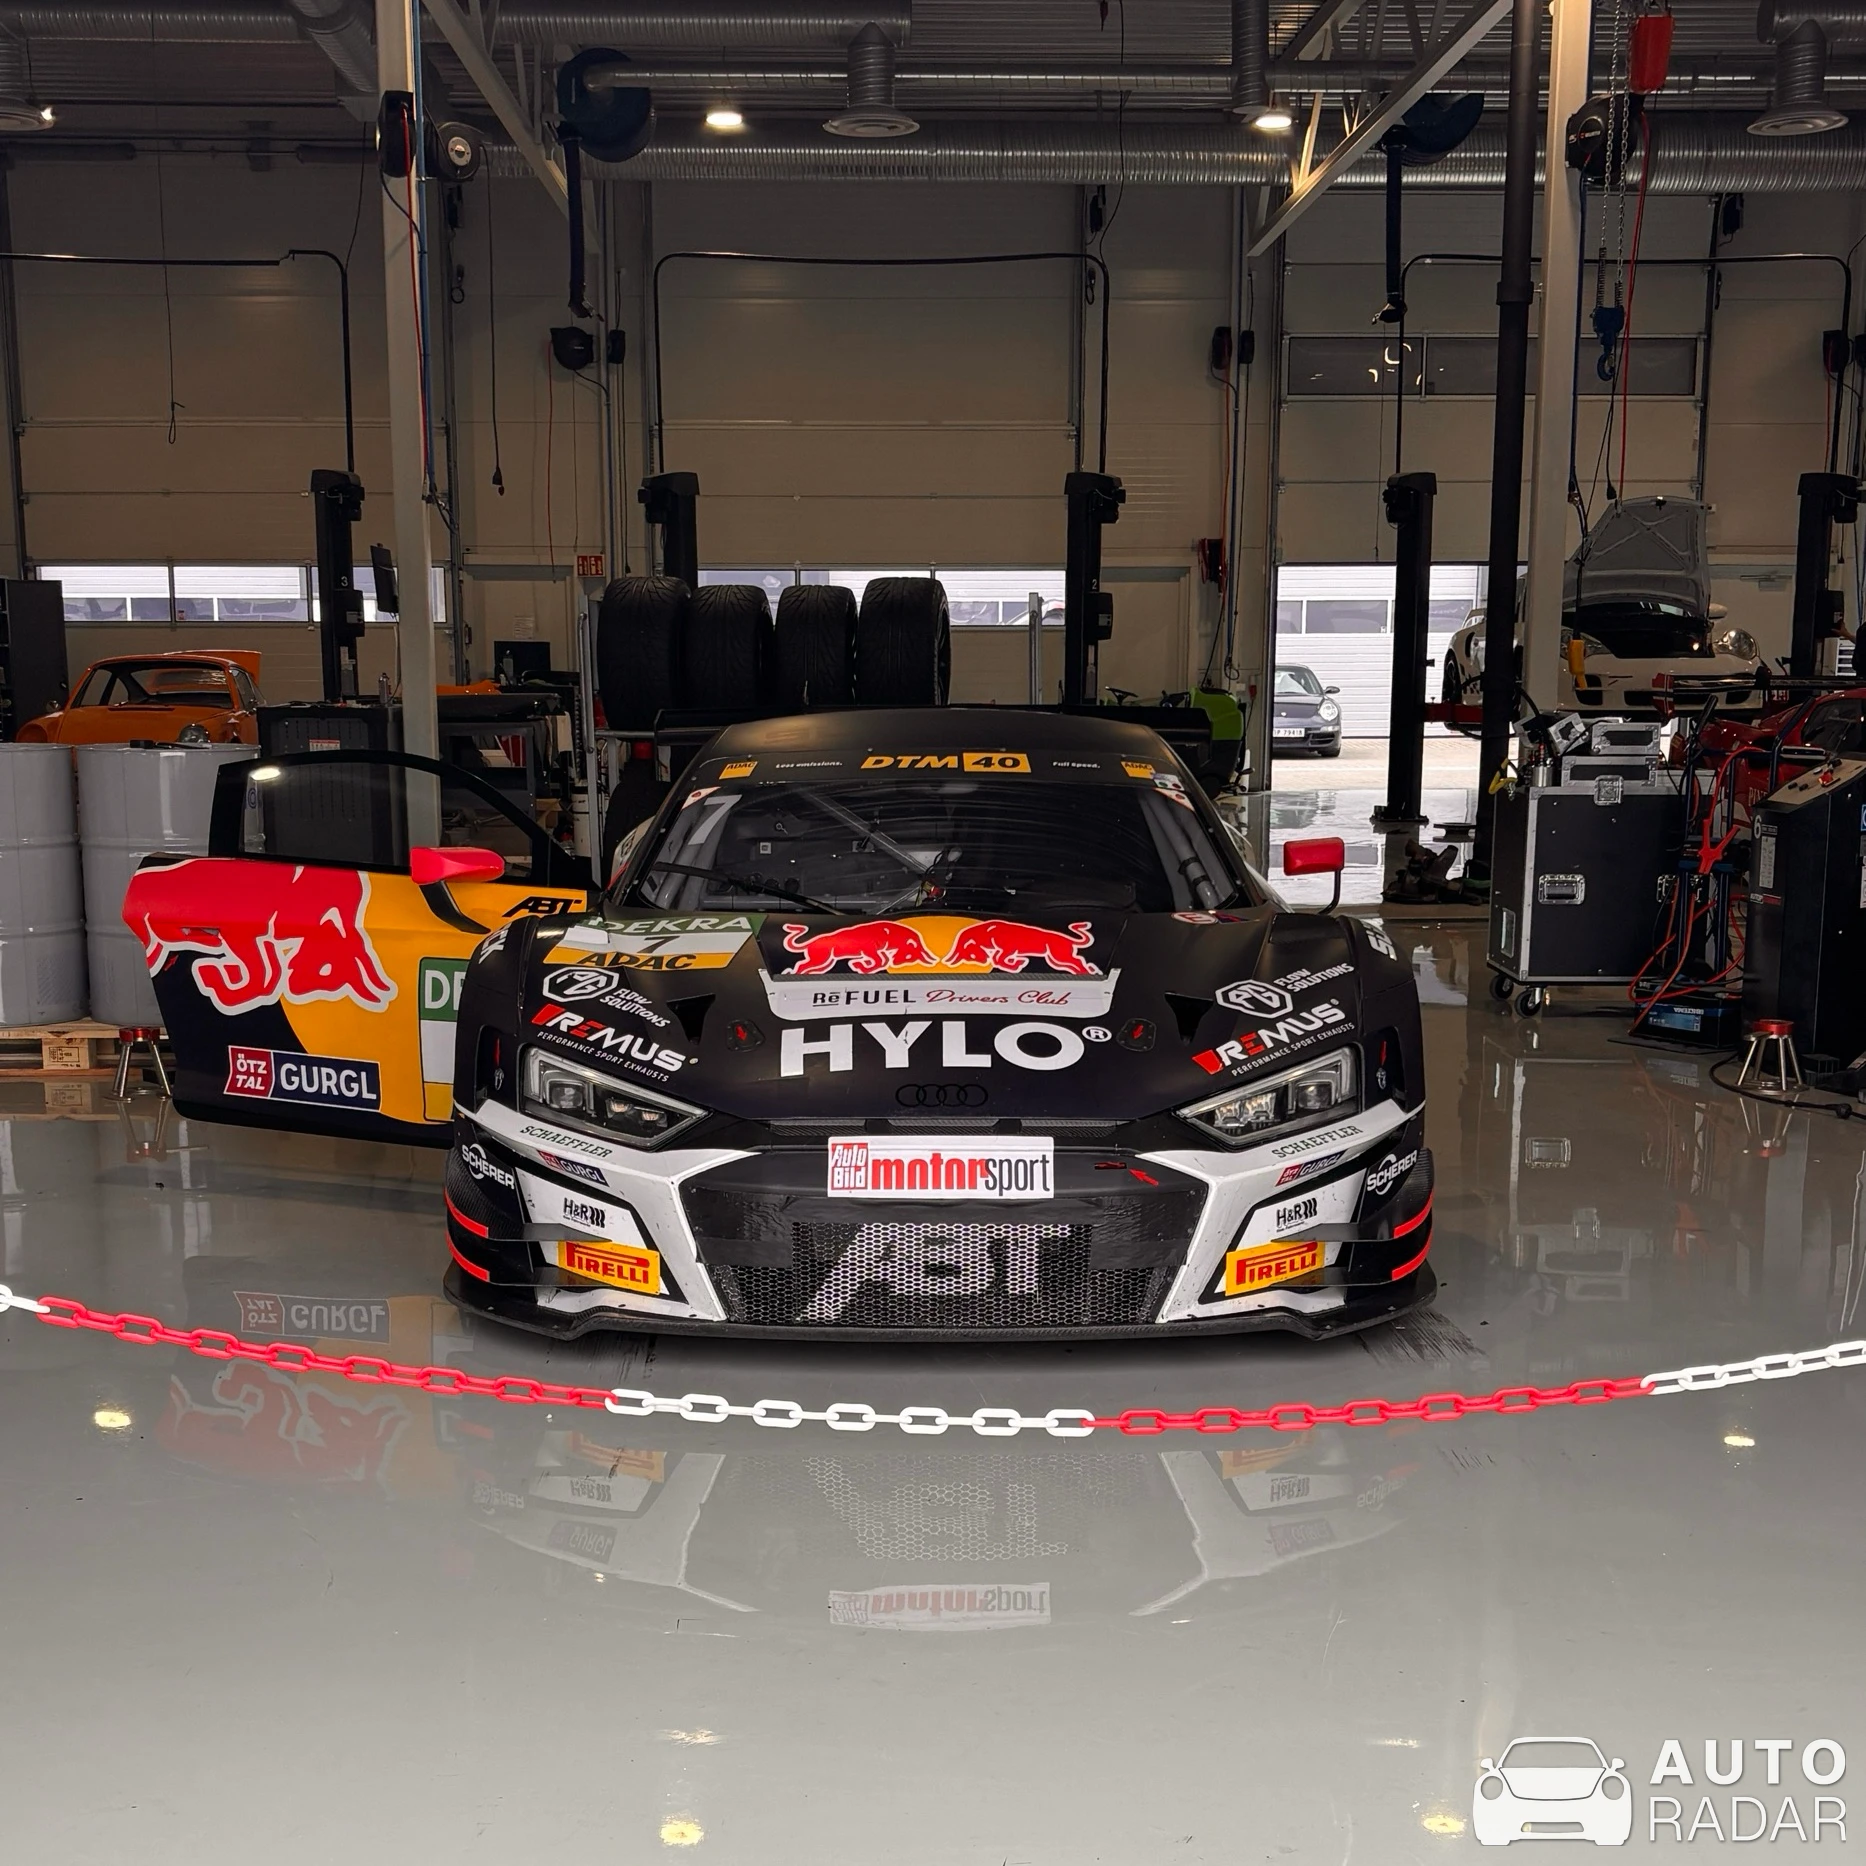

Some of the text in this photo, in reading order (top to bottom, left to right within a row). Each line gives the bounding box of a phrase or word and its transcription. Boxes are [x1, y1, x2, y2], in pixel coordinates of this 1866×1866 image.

[341, 576, 349, 587] 3
[1091, 579, 1097, 590] 2
[726, 761, 756, 771] ADAC
[860, 755, 1021, 769] DTM 40
[1124, 762, 1153, 770] ADAC
[688, 794, 742, 845] 7
[1753, 814, 1762, 839] 6
[502, 896, 583, 917] ABT
[588, 916, 752, 933] DEKRA
[643, 936, 680, 954] 7
[576, 952, 697, 970] ADAC
[1273, 968, 1312, 987] FLOW
[1286, 962, 1355, 993] SOLUTIONS
[612, 988, 653, 1005] FLOW
[926, 989, 1009, 1005] Drivers
[1017, 989, 1073, 1006] Club
[600, 995, 671, 1028] SOLUTIONS
[545, 1010, 687, 1073] REMUS
[1215, 1002, 1347, 1067] REMUS
[537, 1030, 670, 1083] PERFORMANCE SPORT EXHAUSTS
[1231, 1022, 1356, 1078] PERFORMANCE SPORT EXHAUSTS
[236, 1053, 268, 1075] ÖTZ
[236, 1075, 266, 1092] TAL
[280, 1062, 378, 1101] GURGL
[520, 1125, 613, 1159] SCHAEFFLER
[1271, 1125, 1364, 1159] SCHAEFFLER
[461, 1143, 516, 1190] SCHERER
[831, 1143, 868, 1167] Auto
[1300, 1152, 1341, 1177] GURGL
[560, 1160, 607, 1185] GURGL
[832, 1165, 867, 1191] Bild
[871, 1152, 1050, 1197] motorsport
[1366, 1150, 1418, 1194] SCHERER
[566, 1241, 650, 1285] PIRELLI
[796, 1222, 1072, 1321] ABT
[1236, 1241, 1318, 1286] PIRELLI
